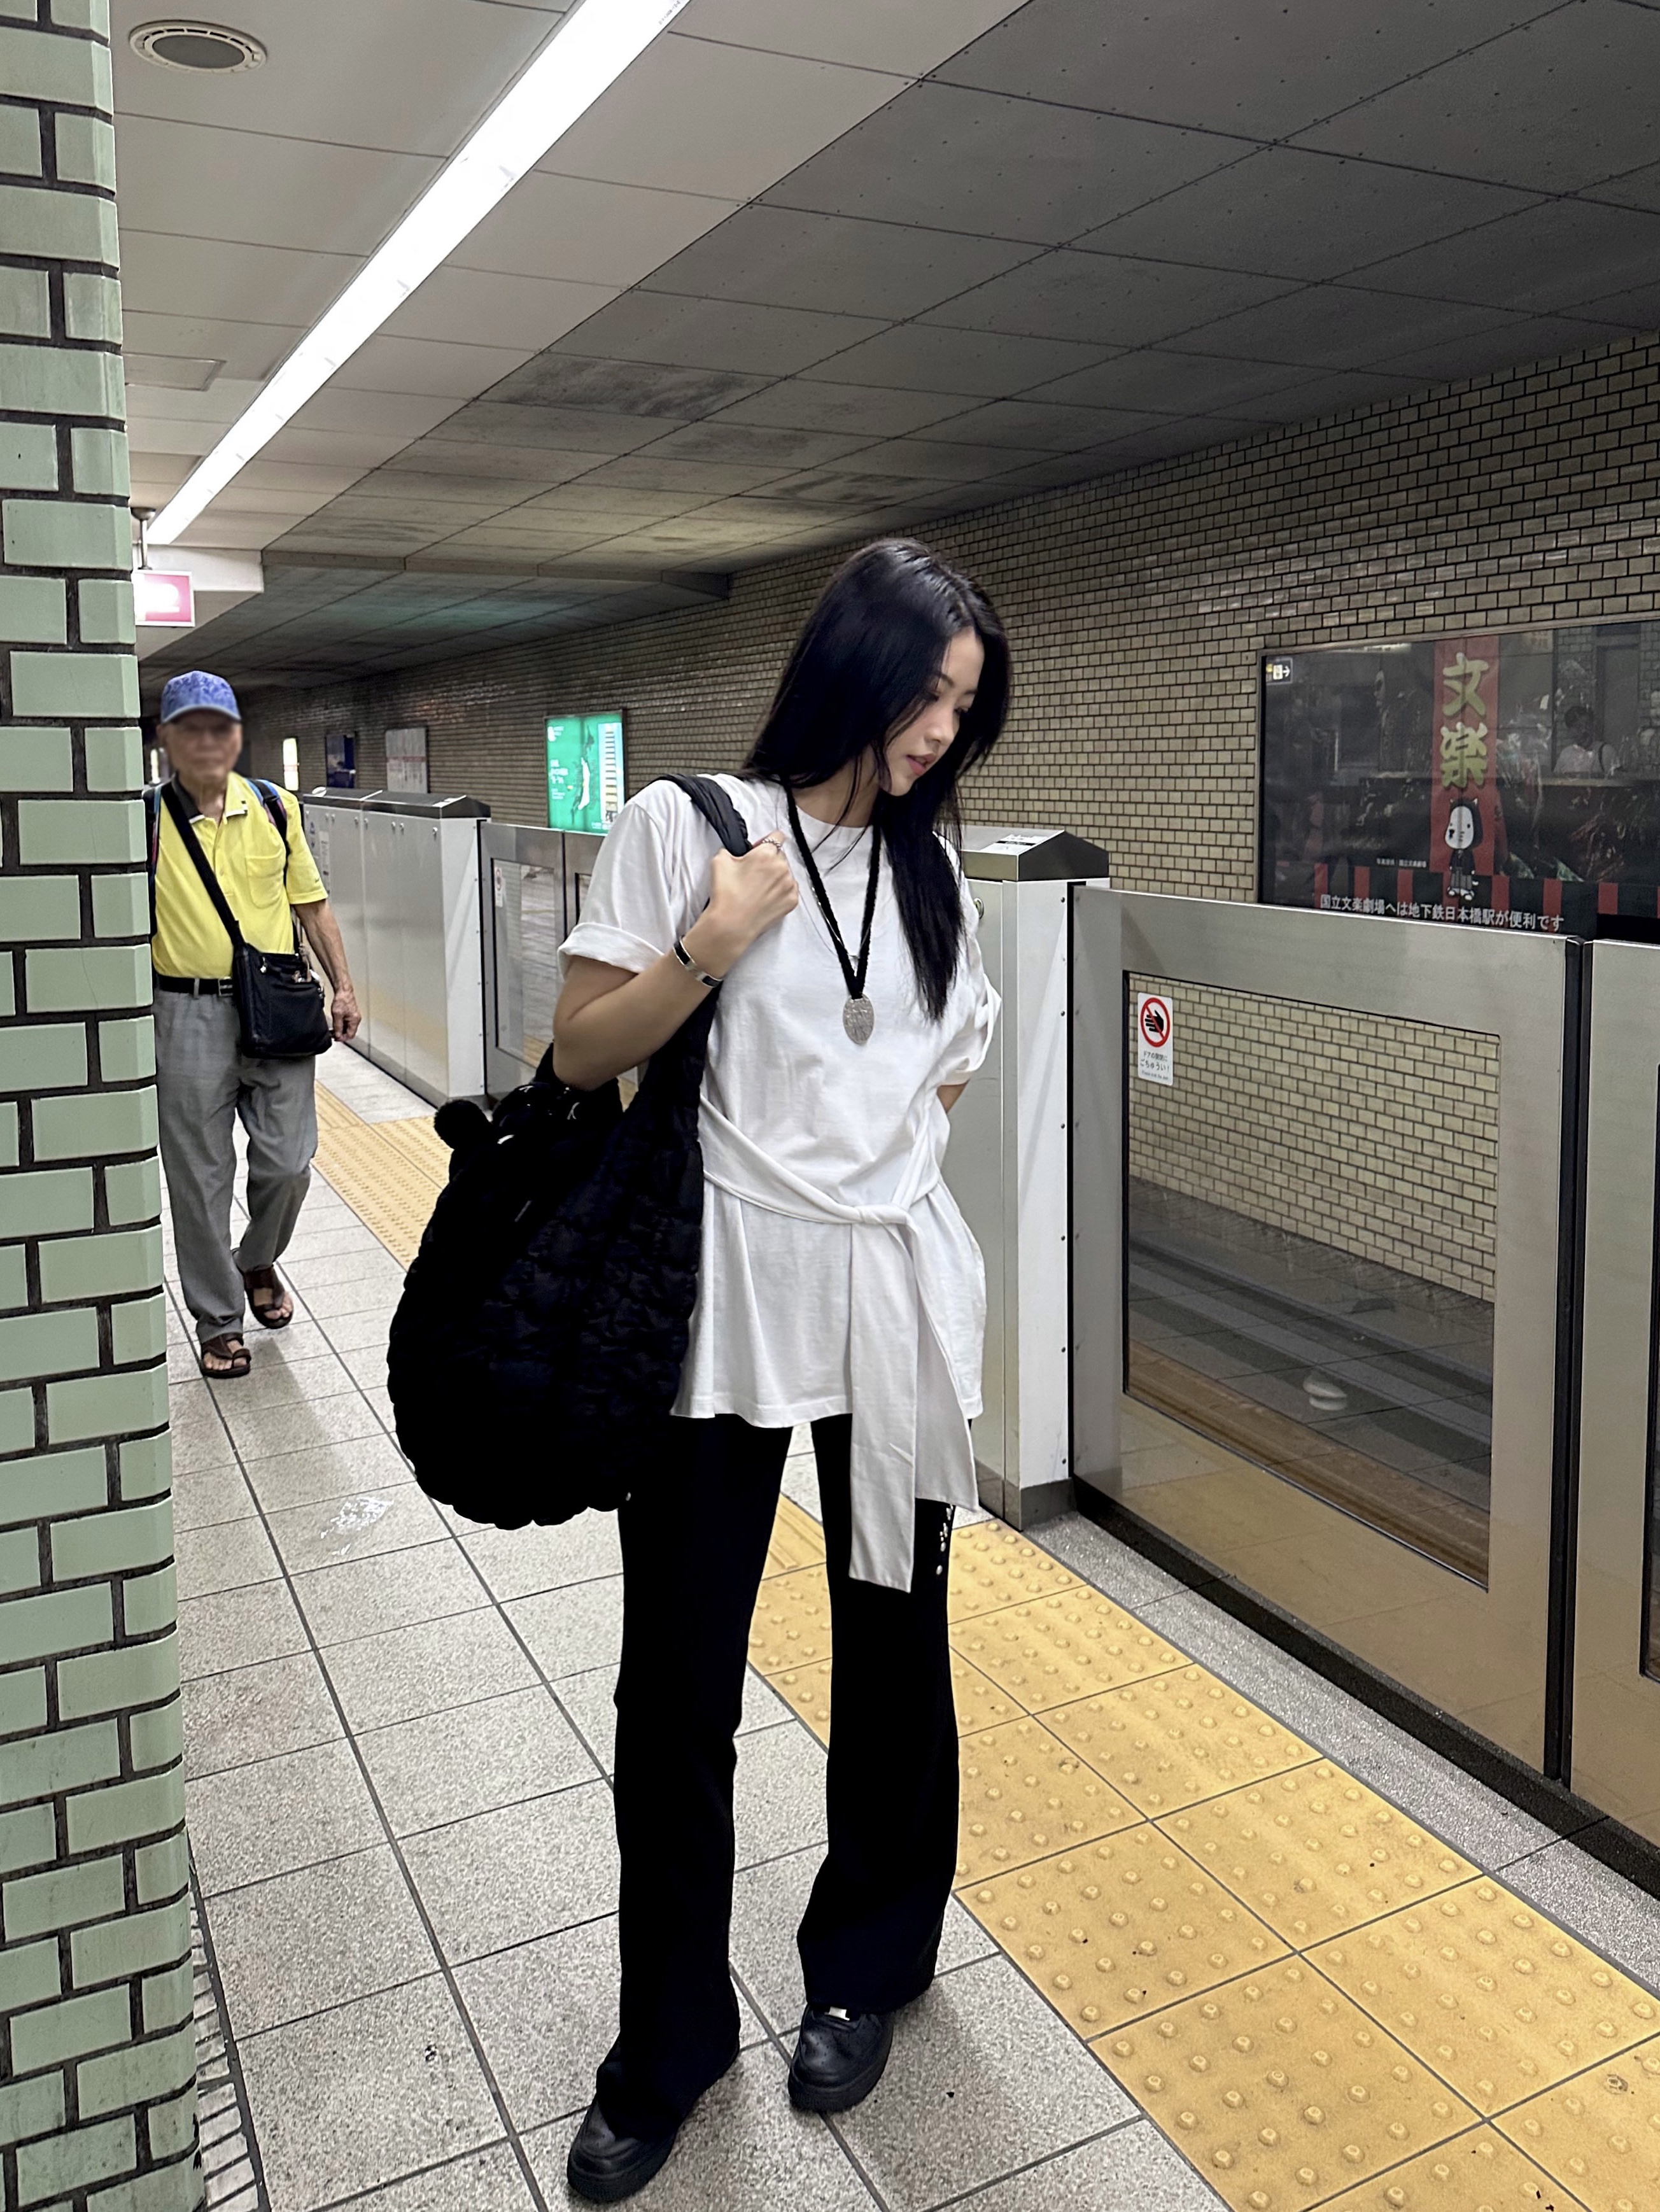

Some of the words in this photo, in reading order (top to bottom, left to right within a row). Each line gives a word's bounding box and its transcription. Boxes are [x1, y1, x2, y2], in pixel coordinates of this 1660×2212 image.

[1440, 652, 1489, 788] 文楽
[1320, 894, 1565, 932] 国立文楽劇場へは地下鉄日本橋駅が便利です
